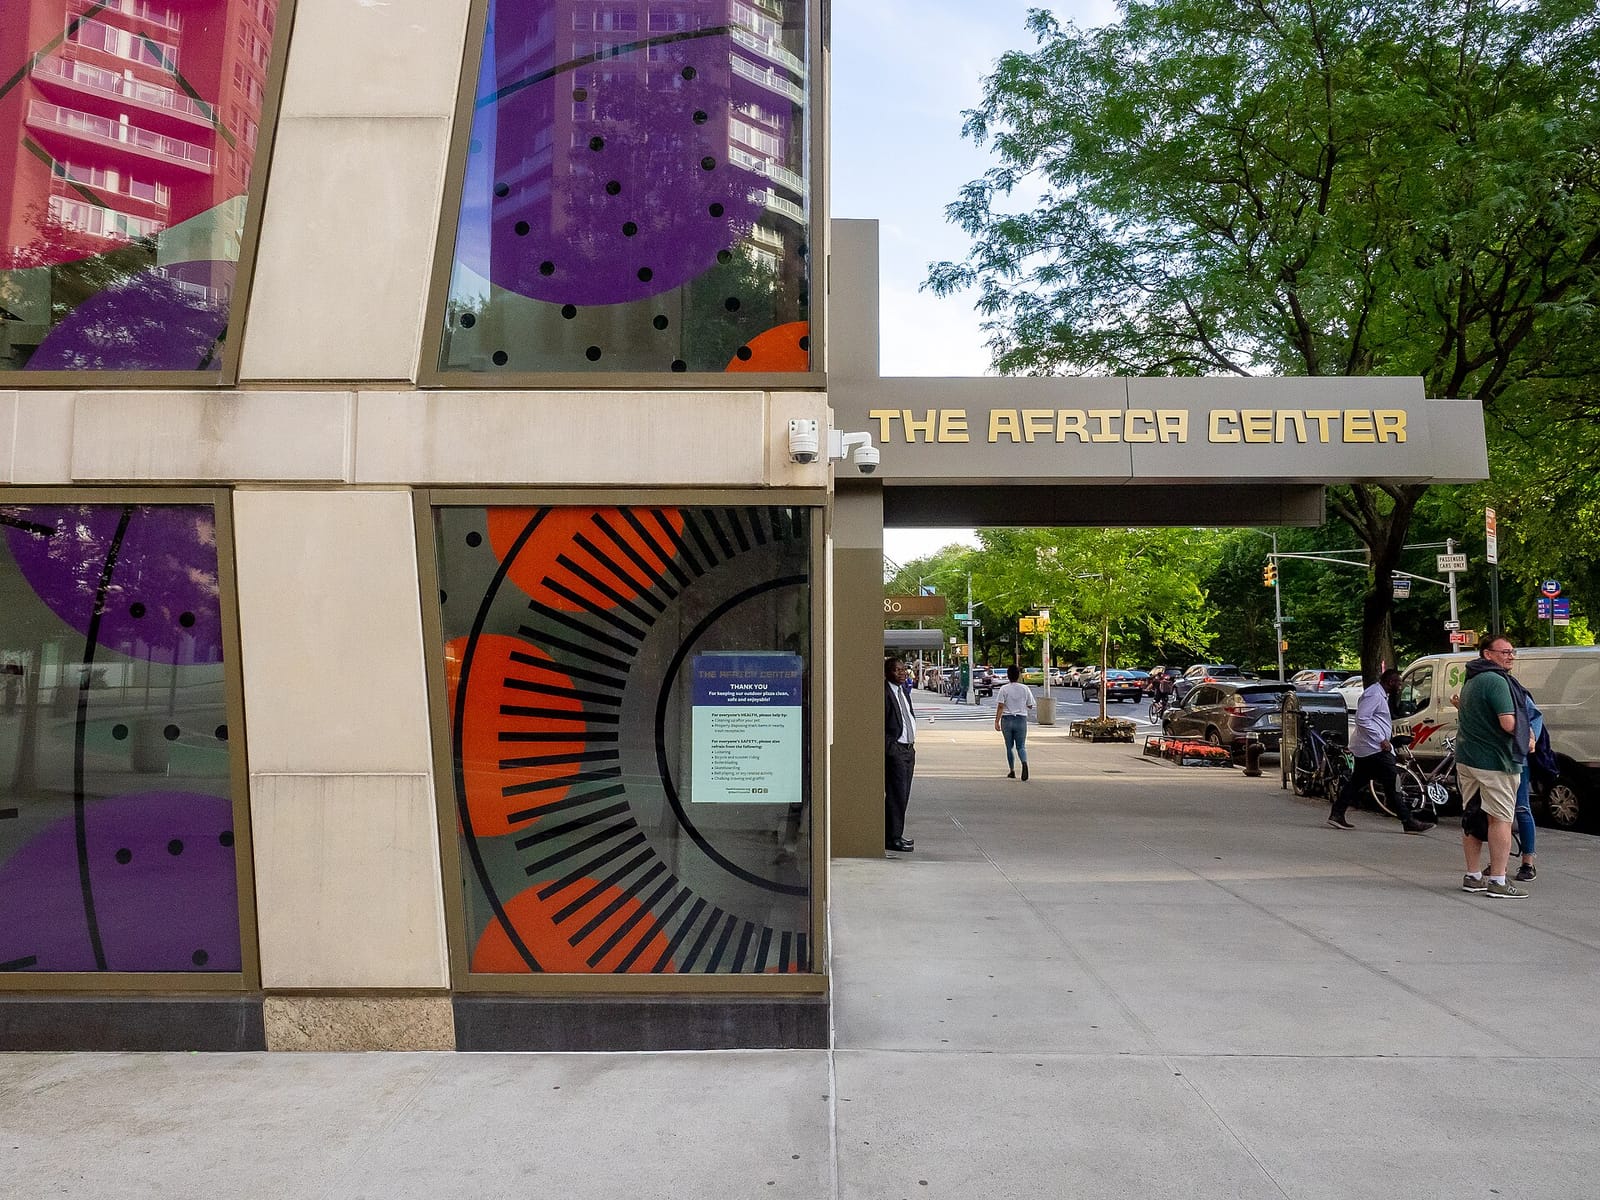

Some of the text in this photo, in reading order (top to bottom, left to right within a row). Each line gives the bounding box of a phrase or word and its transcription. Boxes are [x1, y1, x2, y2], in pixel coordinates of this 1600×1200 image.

[869, 408, 1409, 444] THE AFRICA CENTER
[699, 670, 717, 679] THE
[760, 670, 798, 679] CENTER
